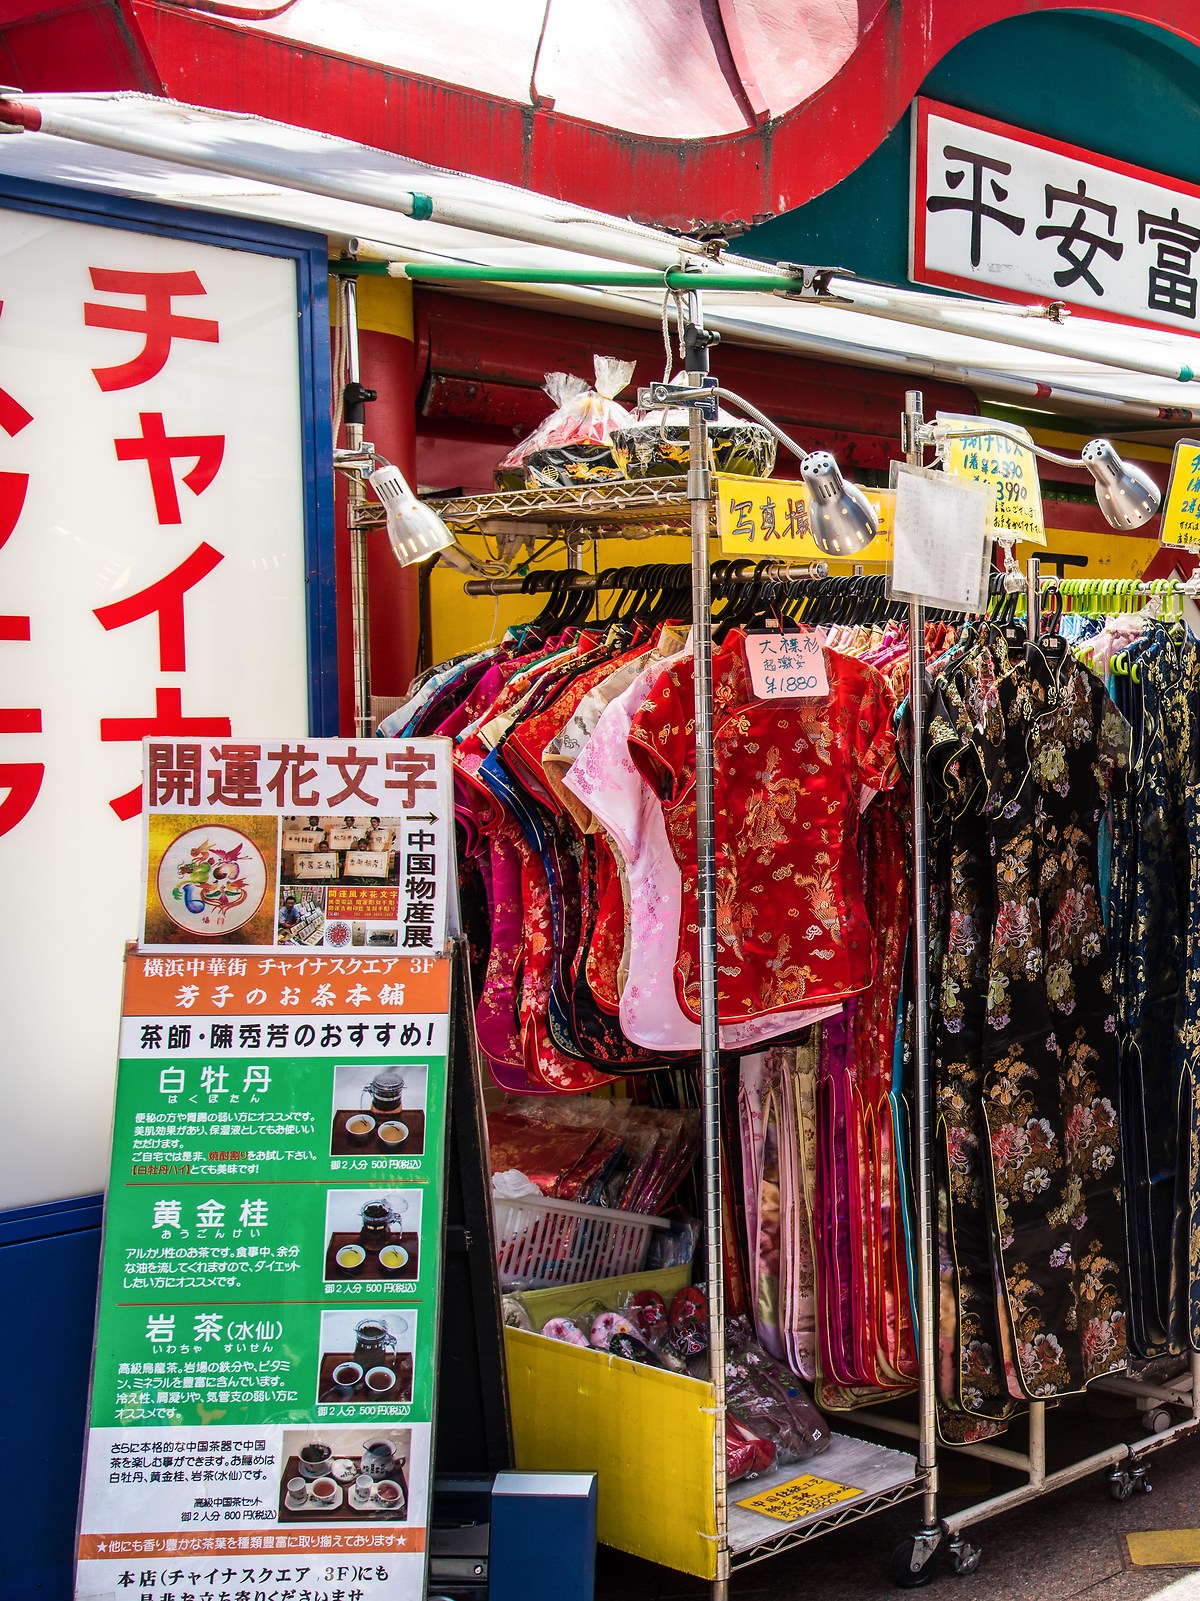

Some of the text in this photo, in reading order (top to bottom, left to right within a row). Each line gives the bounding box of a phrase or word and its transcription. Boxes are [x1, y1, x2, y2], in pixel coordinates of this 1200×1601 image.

[763, 654, 806, 672] 超激安
[149, 743, 438, 809] 開運花文字
[328, 889, 398, 898] 開運風水花文字
[402, 829, 436, 949] 中国物産展
[143, 957, 438, 977] 横浜中華街 チャイナスクエア 3F
[174, 983, 406, 1009] 芳子のお茶本舗
[159, 1065, 272, 1094] 白牡丹
[168, 1094, 261, 1104] はくぼたん
[134, 1112, 316, 1123] 便秘の方や胃腸の弱い方にオススメです。
[133, 1125, 315, 1137] 美肌効果があり、保湿液としてもお使いい
[132, 1139, 184, 1149] ただけます。
[152, 1199, 268, 1229] 黄金桂
[161, 1229, 261, 1239] おうごんけい
[125, 1246, 300, 1259] アルカリ性のお茶です。食事中、余分
[124, 1261, 301, 1274] な油を流してくれますので、ダイエット
[123, 1276, 242, 1289] したい方にオススメです。
[152, 1343, 274, 1354] いわちゃ すいせん
[117, 1360, 291, 1374] 高級烏龍茶。岩場の鉄分や、ビタミ
[116, 1376, 286, 1390] ン、ミネラルを豊富に含んでいます。
[115, 1391, 298, 1405] 冷え性、肩凝りや、気管支の弱い方に
[114, 1406, 182, 1419] オススメです。
[111, 1440, 266, 1454] さらに本格的な中国茶器で中国
[193, 1497, 263, 1508] 高級中国茶セット
